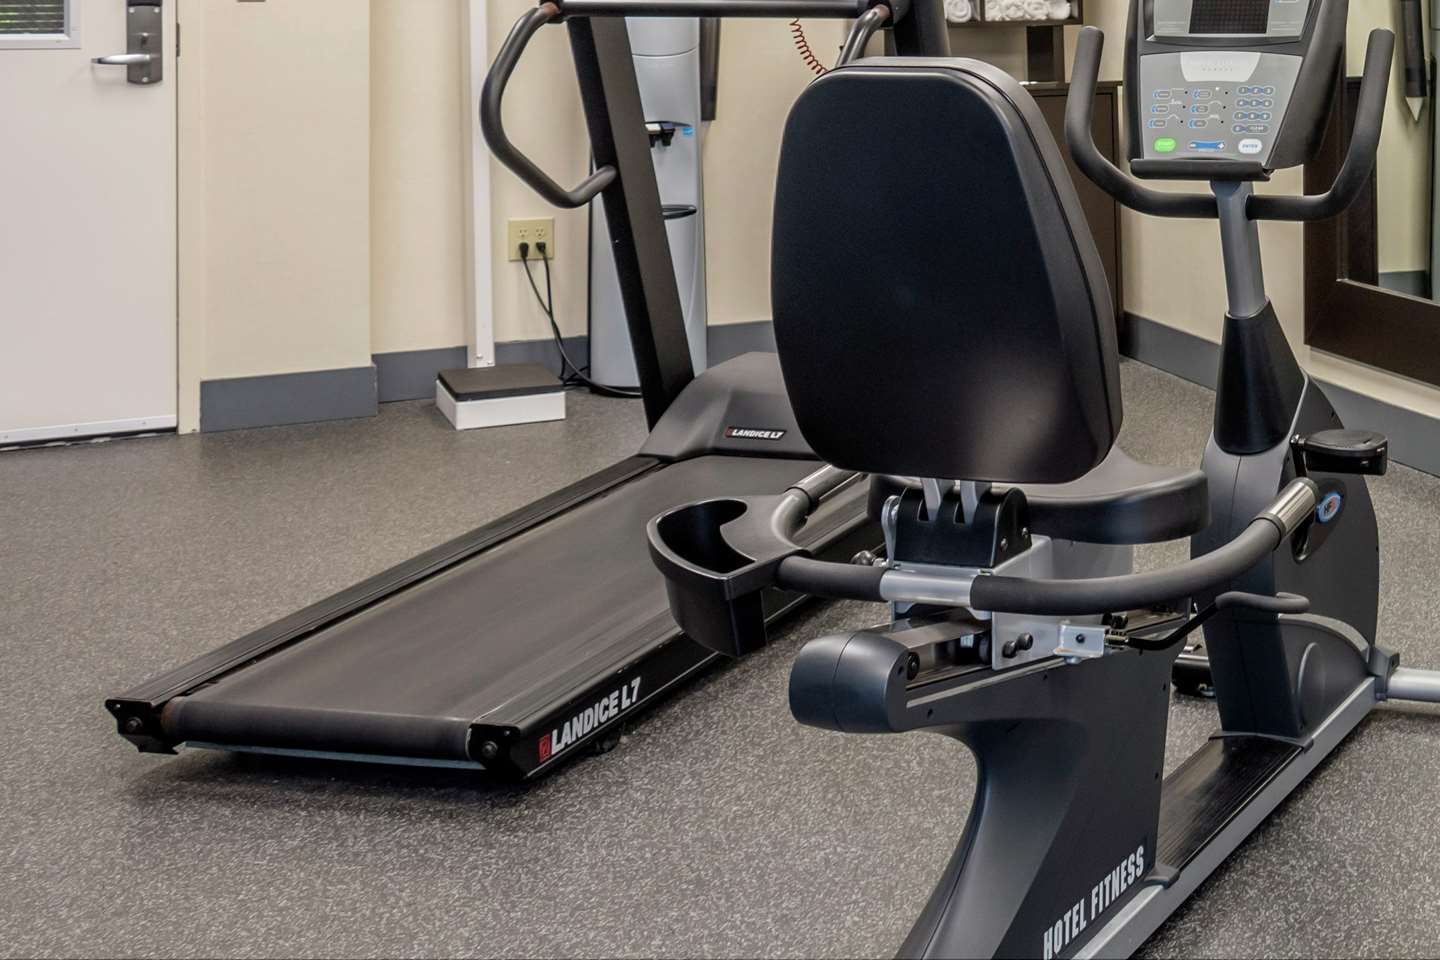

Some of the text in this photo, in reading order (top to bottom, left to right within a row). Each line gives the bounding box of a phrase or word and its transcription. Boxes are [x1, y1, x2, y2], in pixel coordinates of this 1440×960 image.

[732, 428, 783, 439] LANDICE L7
[551, 676, 641, 756] LANDICE L7
[1043, 845, 1144, 960] HOTEL FITNESS
